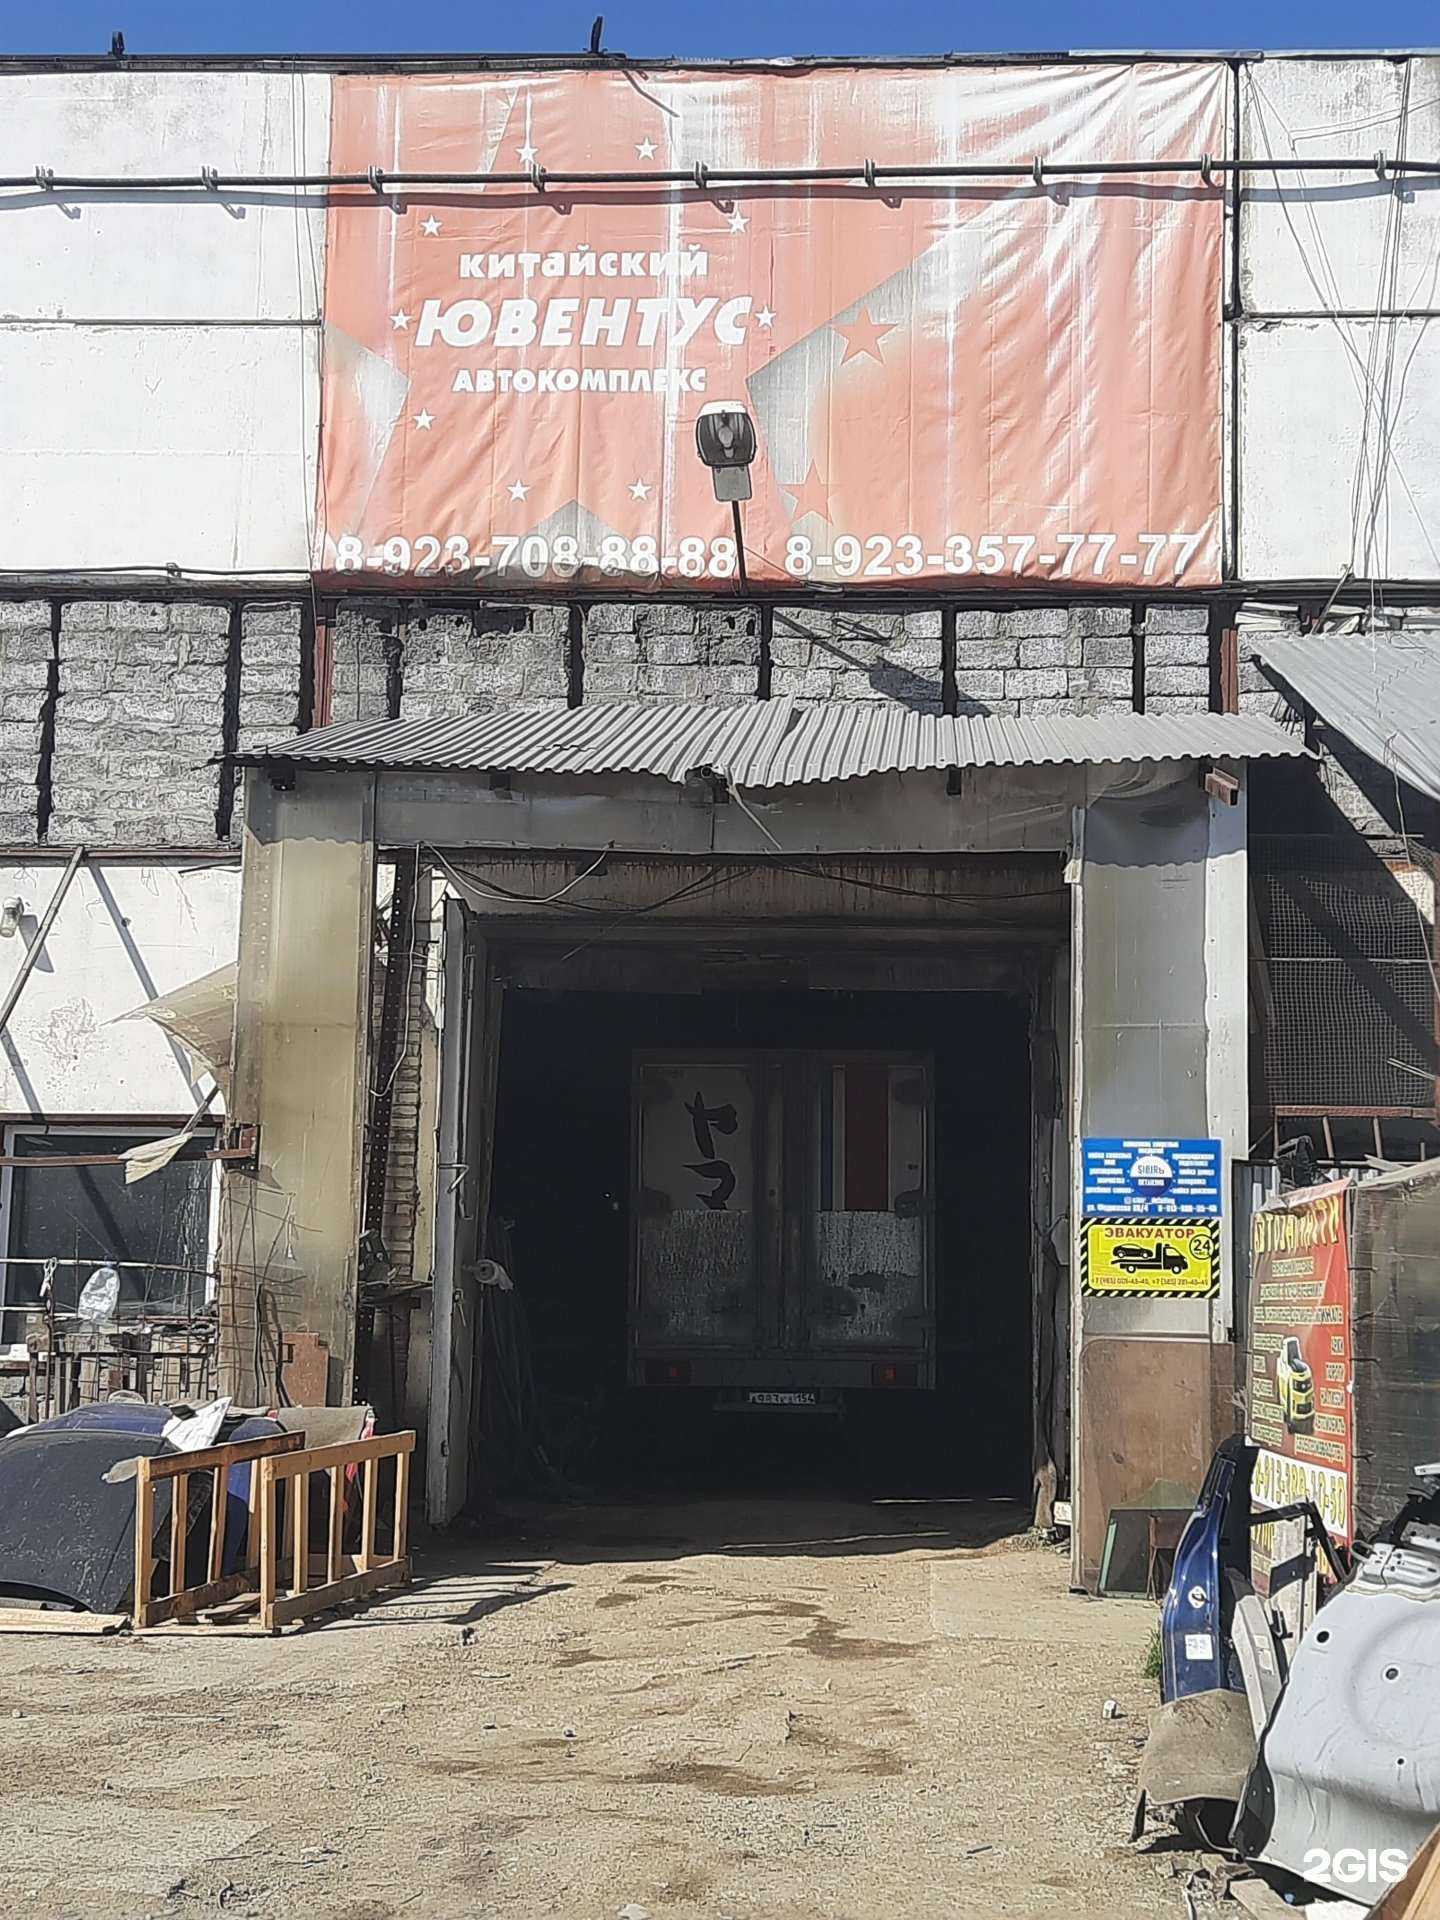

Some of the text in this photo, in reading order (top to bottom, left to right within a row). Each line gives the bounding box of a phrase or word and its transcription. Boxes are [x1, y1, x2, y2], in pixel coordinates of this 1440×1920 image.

[414, 296, 753, 348] ЮВЕНТУС
[452, 368, 707, 393] АВТОКОМПЛЕКС
[334, 535, 738, 578] 8-923-708-88-88
[784, 534, 1200, 578] 8-923-357-77-77
[1104, 1227, 1195, 1239] ЭВАКУАТОР
[1193, 1239, 1211, 1252] 24
